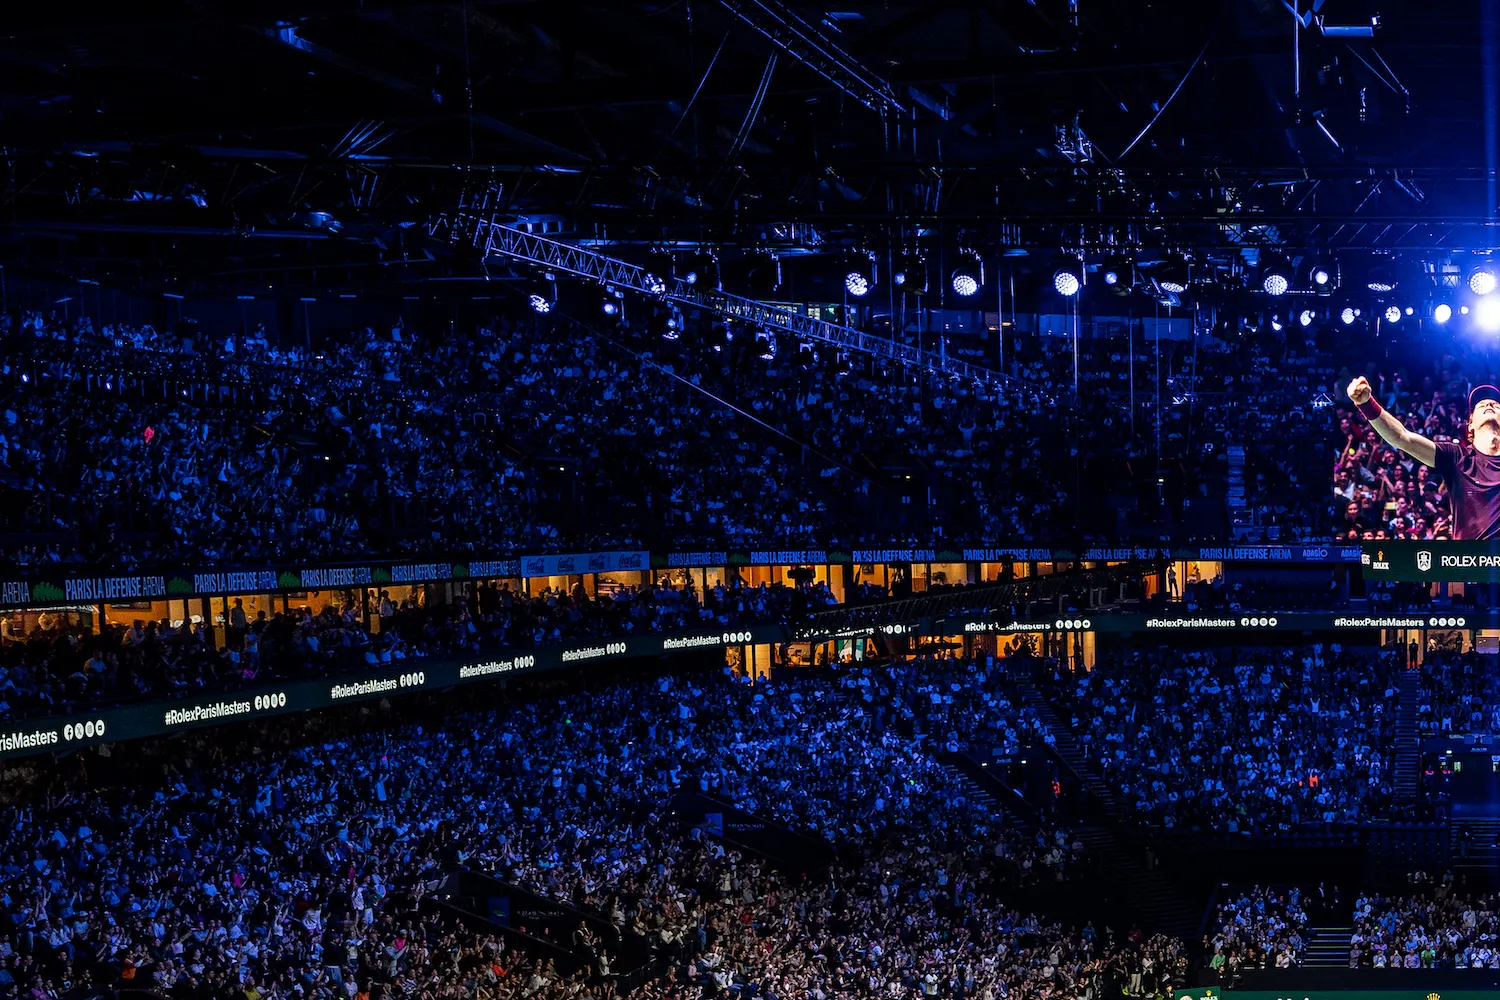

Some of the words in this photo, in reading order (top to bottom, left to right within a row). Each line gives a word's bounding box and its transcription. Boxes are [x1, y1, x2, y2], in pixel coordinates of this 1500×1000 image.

[751, 551, 770, 564] PARIS
[770, 551, 777, 564] LA
[807, 550, 827, 563] ARENA
[853, 550, 872, 562] PARIS
[873, 550, 882, 561] LA
[963, 549, 984, 561] PARIS
[985, 549, 995, 560] LA
[1029, 549, 1052, 560] ARENA
[1103, 549, 1112, 559] LA
[1200, 548, 1223, 560] PARIS
[1224, 548, 1234, 560] LA
[1234, 548, 1269, 560] DEFENSE
[1269, 548, 1292, 560] ARENA
[1303, 548, 1328, 558] ADAGIO
[1373, 562, 1390, 570] ROLEX
[1440, 555, 1475, 567] ROLEX
[194, 573, 216, 593] PARIS
[217, 572, 228, 592] LA
[227, 571, 258, 591] DEFENSE
[258, 570, 278, 590] ARENA
[301, 569, 320, 588] PARIS
[320, 568, 330, 586] LA
[355, 566, 372, 584] ARENA
[2, 581, 31, 603] ARENA
[65, 579, 93, 601] PARIS
[93, 578, 104, 599] LA
[104, 577, 141, 599] DEFENSE
[142, 576, 166, 597] ARENA
[1146, 618, 1236, 629] #RolexParisMasters
[1334, 618, 1425, 628] #RolexParisMasters
[663, 636, 720, 650] #RolexParisMasters
[460, 661, 512, 679] #RolexParisMasters
[331, 678, 397, 699] #RolexParisMasters
[165, 700, 250, 726] #RolexParisMasters
[0, 729, 58, 752] risMasters
